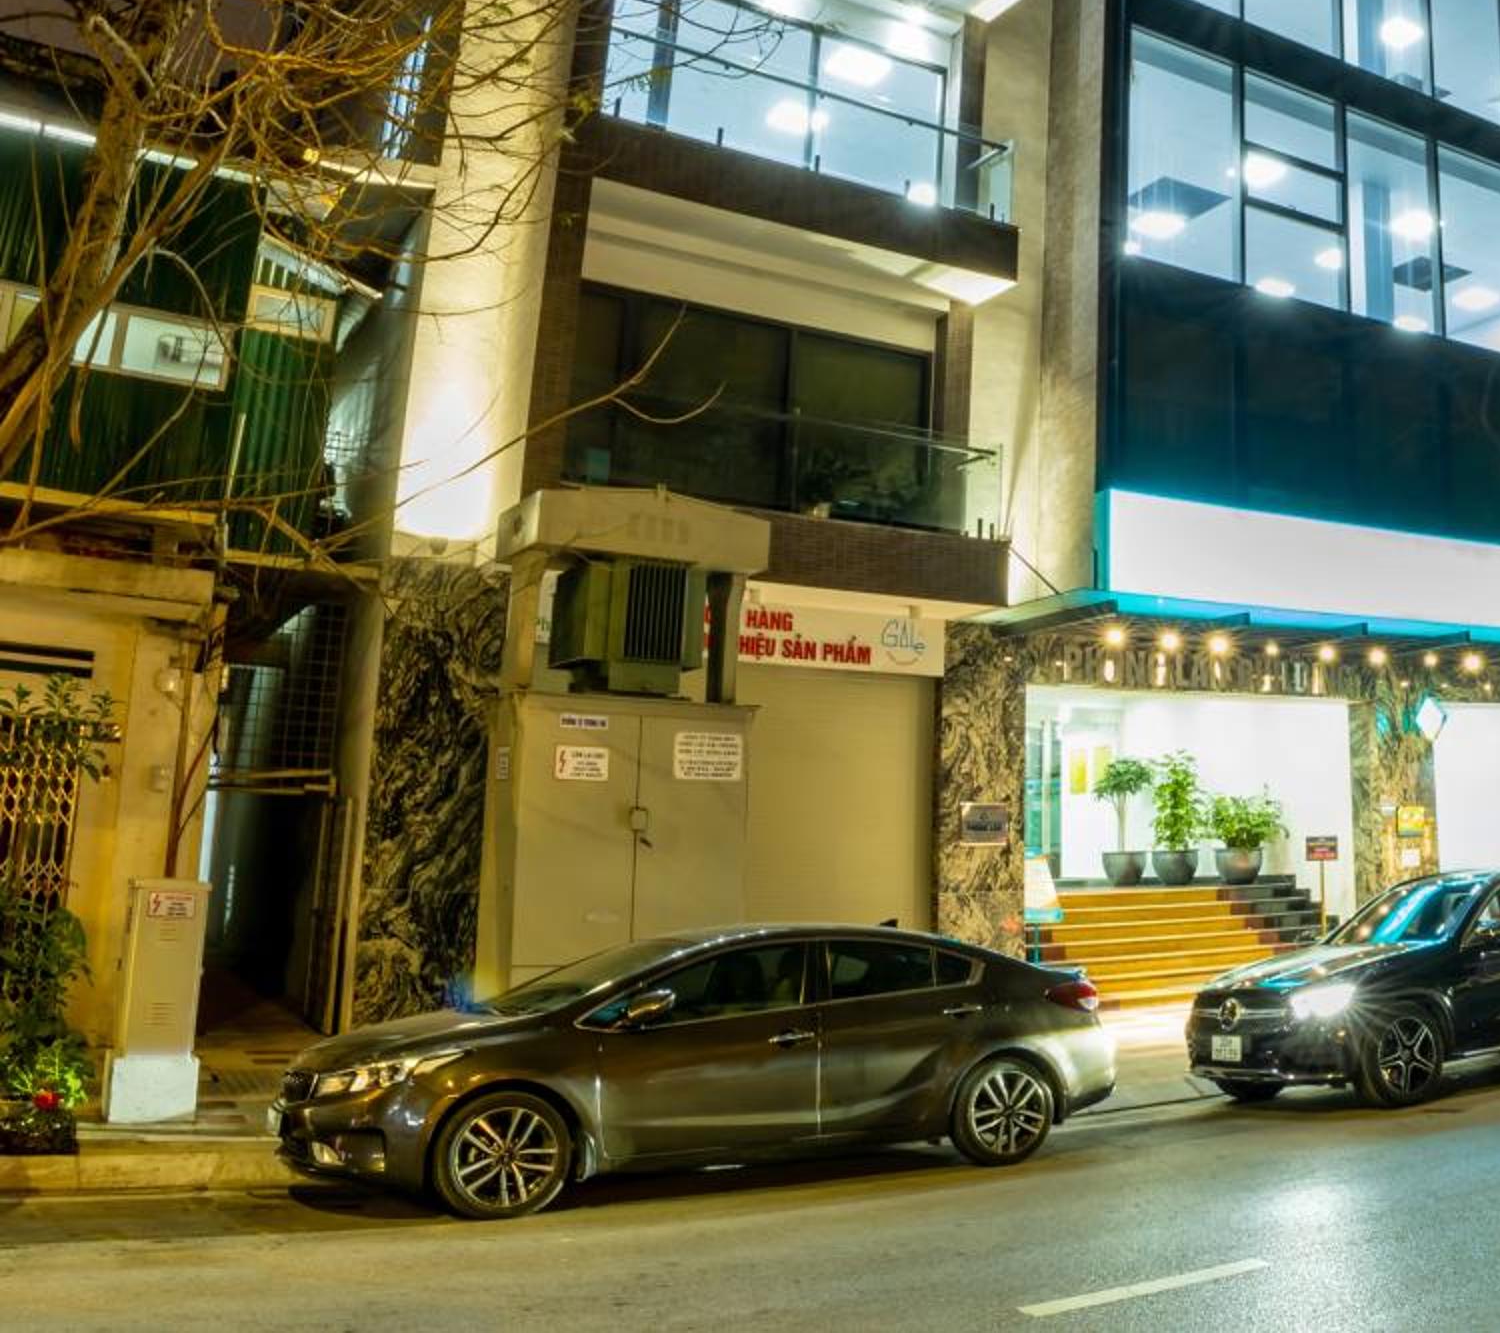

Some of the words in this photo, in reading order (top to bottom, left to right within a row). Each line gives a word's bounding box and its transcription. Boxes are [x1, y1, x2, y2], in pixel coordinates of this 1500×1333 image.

[746, 606, 794, 632] HÀNG
[738, 632, 776, 660] HIỆU
[781, 634, 817, 661] SẢN
[821, 635, 872, 665] PHẨM
